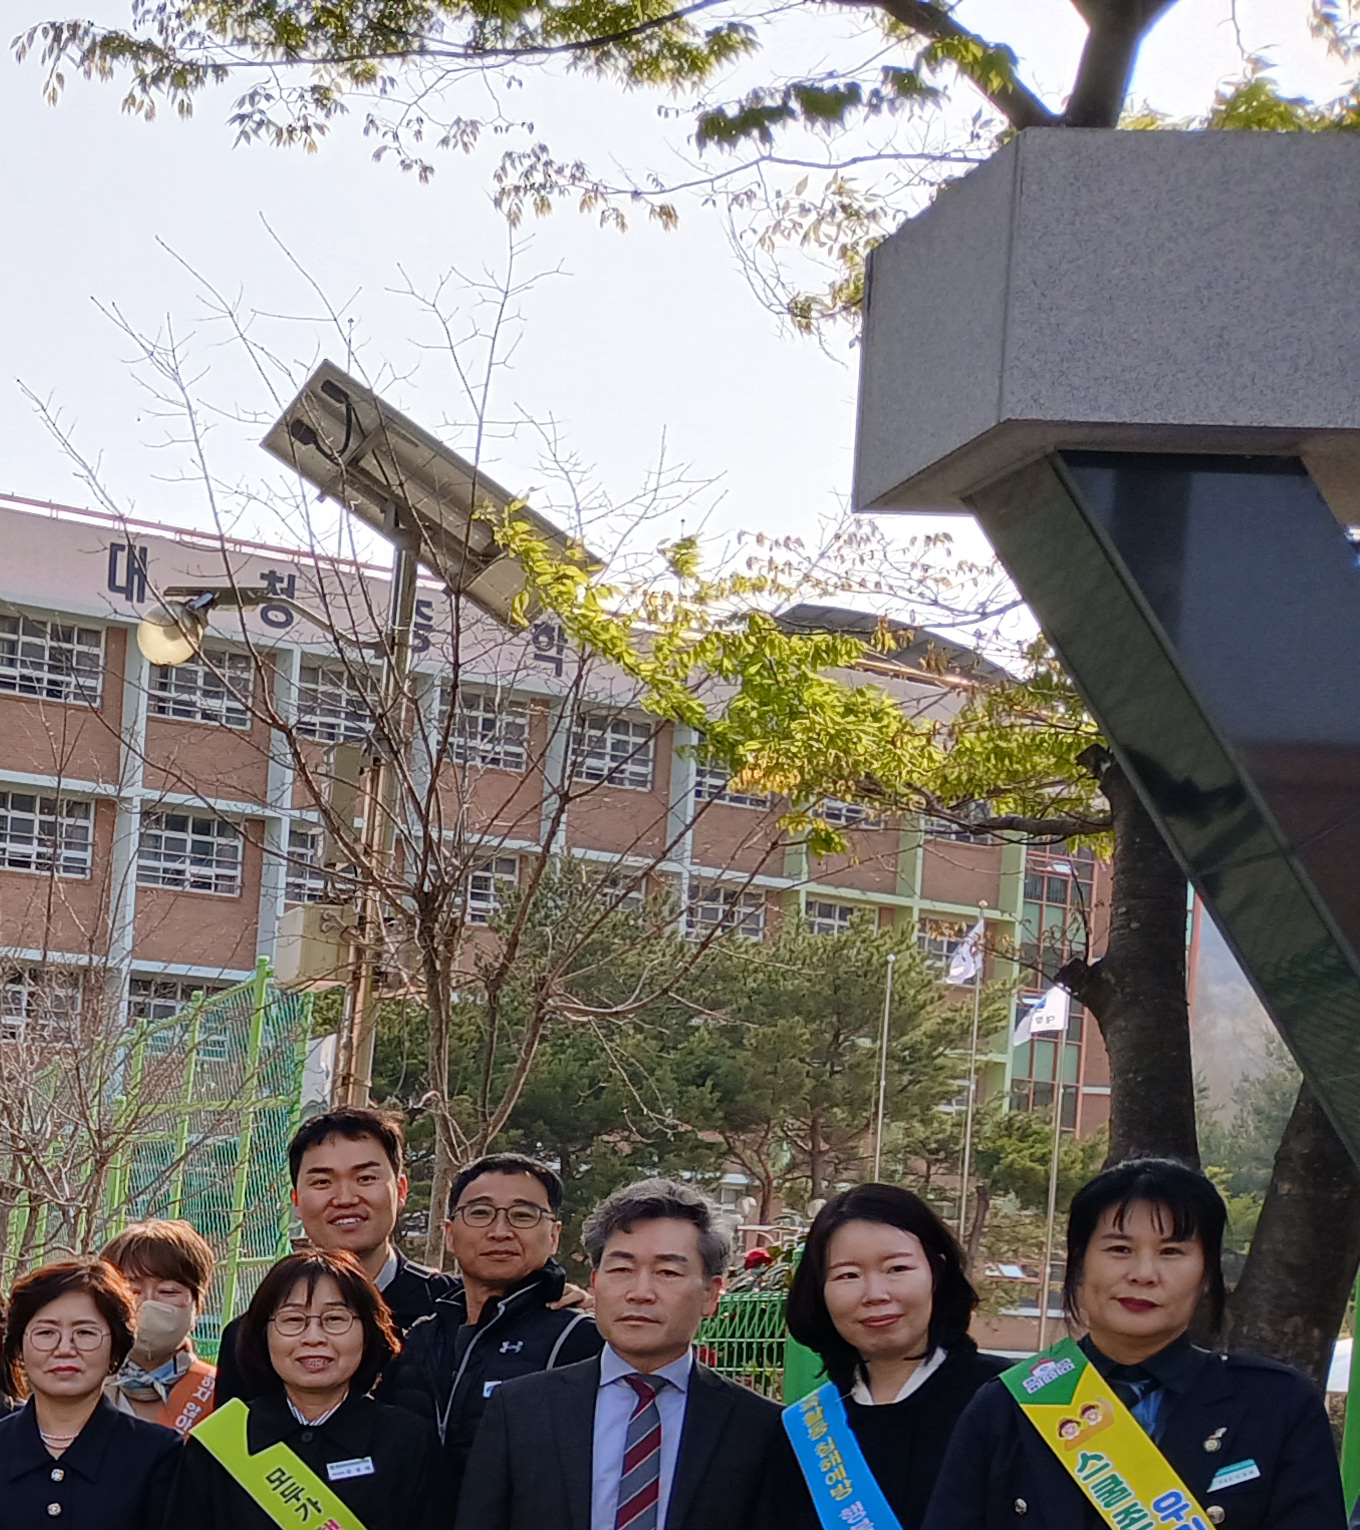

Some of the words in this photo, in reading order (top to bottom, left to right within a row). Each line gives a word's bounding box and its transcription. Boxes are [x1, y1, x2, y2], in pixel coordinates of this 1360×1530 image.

[174, 1400, 204, 1436] 않아
[265, 1467, 324, 1522] 모두가
[814, 1436, 854, 1502] 침해예방
